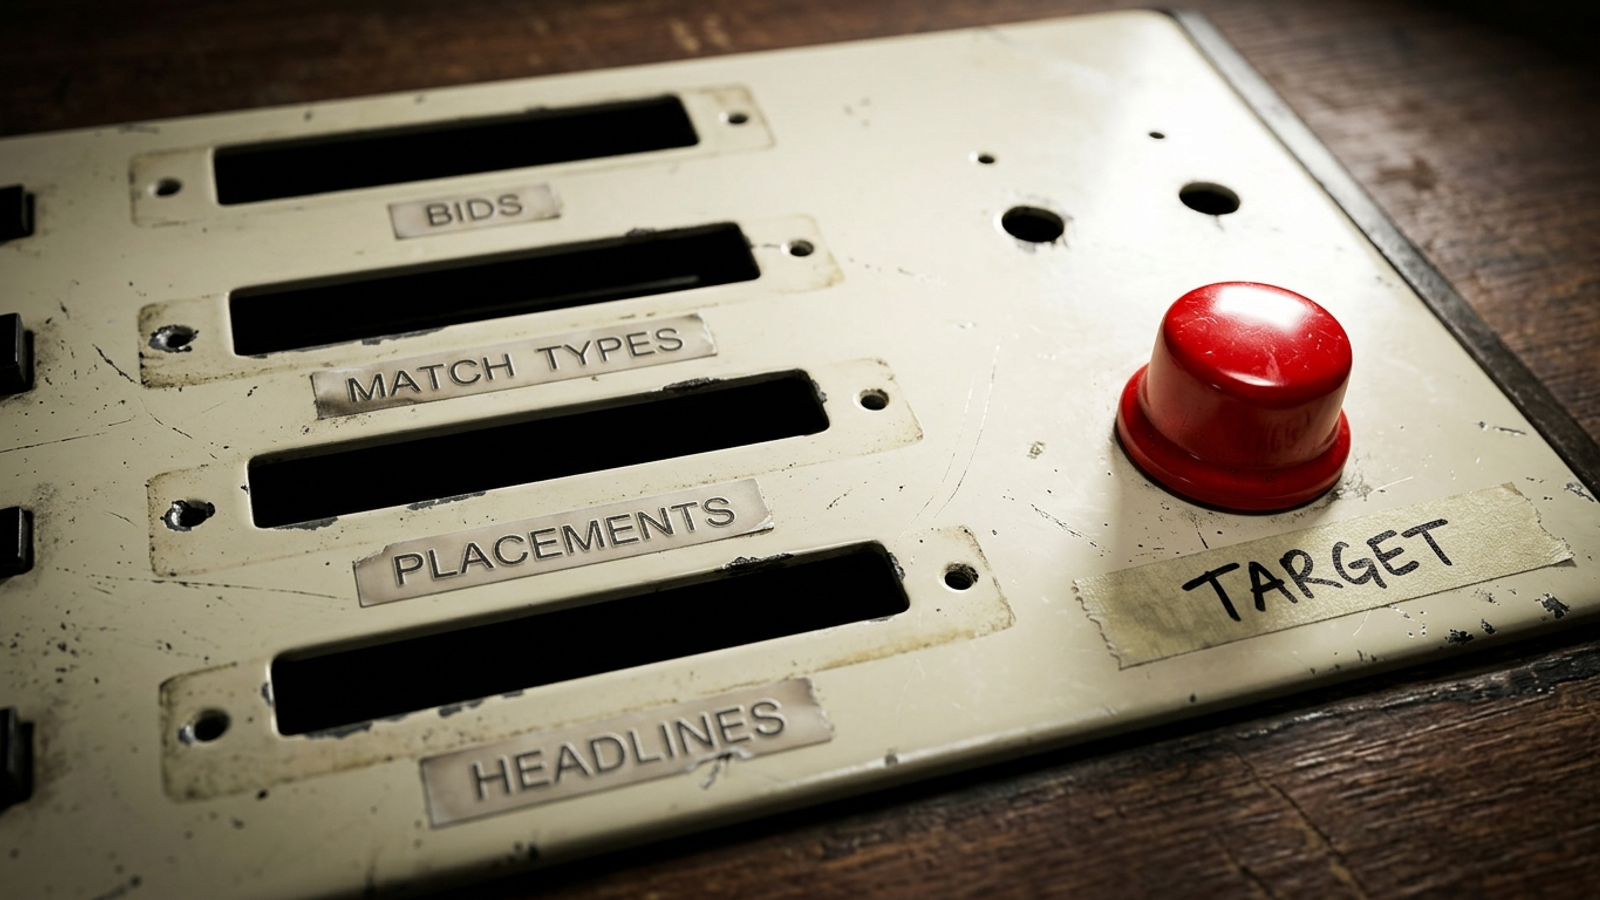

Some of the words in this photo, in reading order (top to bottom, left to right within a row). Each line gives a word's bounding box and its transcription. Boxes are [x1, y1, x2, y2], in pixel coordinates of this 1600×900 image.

[426, 193, 524, 227] BIDS
[345, 352, 514, 404] MATCH
[536, 327, 684, 371] TYPES
[393, 496, 735, 586] PLACEMENTS
[1182, 519, 1453, 621] TARGET
[472, 699, 786, 801] HEADLINES
